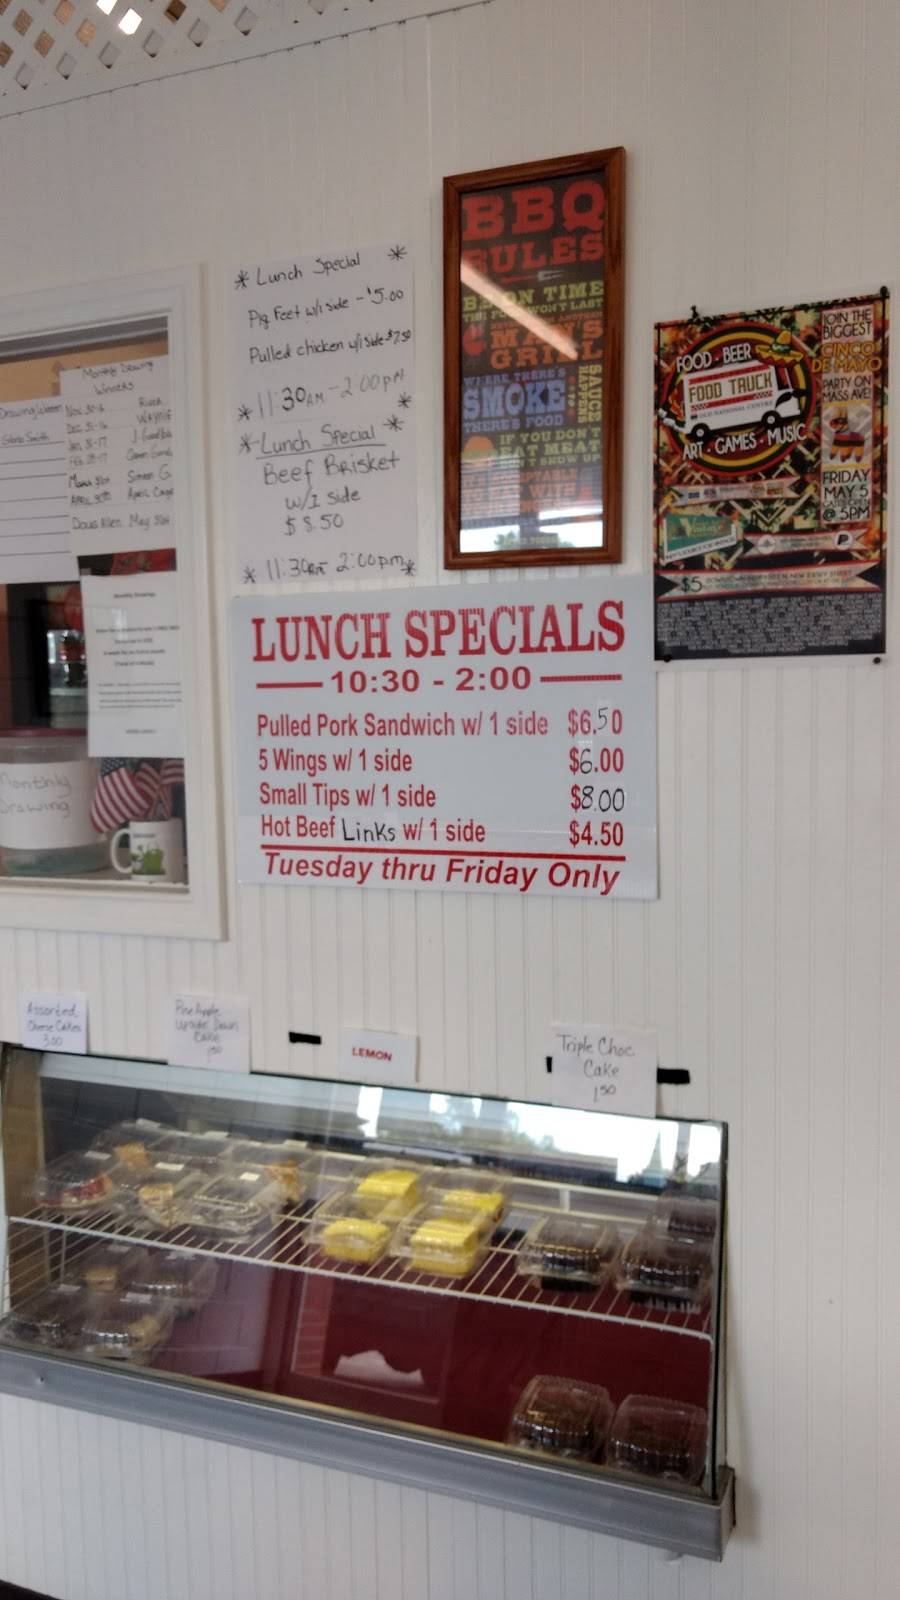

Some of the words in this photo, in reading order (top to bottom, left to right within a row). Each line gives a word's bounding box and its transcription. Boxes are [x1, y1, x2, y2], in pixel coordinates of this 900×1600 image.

[462, 179, 606, 242] BBQ
[463, 232, 604, 277] RULES
[257, 265, 303, 286] Lunch
[313, 252, 361, 276] Special
[544, 281, 604, 301] TIME
[248, 309, 270, 330] Pig
[274, 304, 300, 321] Feet
[325, 298, 350, 313] side
[823, 311, 849, 326] JOIN
[851, 308, 872, 322] THE
[822, 322, 873, 340] BIGGEST
[249, 343, 291, 364] Pulled
[296, 338, 344, 357] chicken
[676, 351, 713, 373] FOOD
[722, 343, 752, 363] BEER
[821, 341, 876, 358] CINCO
[811, 359, 832, 375] DE
[833, 356, 882, 374] MAYO
[688, 381, 723, 404] FOOD
[730, 373, 773, 395] TRUCK
[822, 376, 851, 391] PARTY
[853, 375, 872, 388] ON
[463, 379, 568, 421] SMOKE
[822, 390, 850, 404] MASS
[525, 413, 565, 429] FOOD
[260, 429, 312, 455] Lunch
[321, 423, 377, 447] Special
[499, 433, 517, 446] IF
[520, 428, 553, 444] YOU
[500, 444, 539, 461] EAT
[544, 438, 602, 456] MEAT
[682, 441, 705, 461] ART
[714, 433, 757, 456] GAMES
[767, 423, 808, 447] MUSIC
[582, 454, 601, 465] UP
[264, 458, 313, 489] Beef
[822, 470, 869, 486] FRIDAY
[327, 486, 360, 506] side
[823, 485, 857, 500] MAY
[860, 484, 870, 498] 5
[838, 505, 871, 521] 5PM
[680, 576, 702, 593] $5
[251, 612, 392, 662] LUNCH
[405, 600, 625, 659] SPECIALS
[330, 669, 421, 694] 10:30
[455, 666, 532, 692] 2:00
[257, 713, 312, 737] Pulled
[316, 713, 359, 737] Pork
[364, 711, 455, 737] Sandwich
[460, 711, 484, 736] w/
[488, 711, 499, 736] 1
[506, 710, 549, 736] side
[567, 707, 624, 738] $6.50
[259, 748, 269, 771] 5
[273, 747, 328, 778] Wings
[333, 747, 353, 772] w/
[358, 748, 367, 771] 1
[374, 748, 414, 772] side
[569, 746, 625, 776] $6.00
[260, 781, 308, 806] Small
[312, 782, 351, 812] Tips
[356, 783, 376, 807] w/
[381, 783, 391, 807] 1
[396, 784, 437, 808] side
[570, 784, 626, 813] $8.00
[261, 814, 292, 838] Hot
[296, 815, 337, 839] Beef
[403, 817, 424, 841] w/
[429, 818, 439, 841] 1
[445, 818, 487, 843] side
[569, 819, 625, 848] $4.50
[265, 851, 375, 885] Tuesday
[382, 856, 437, 882] thru
[445, 858, 540, 893] Friday
[547, 861, 622, 896] Only
[352, 1047, 393, 1062] LEMON
[557, 1033, 594, 1058] Triple
[583, 1057, 621, 1079] Cake
